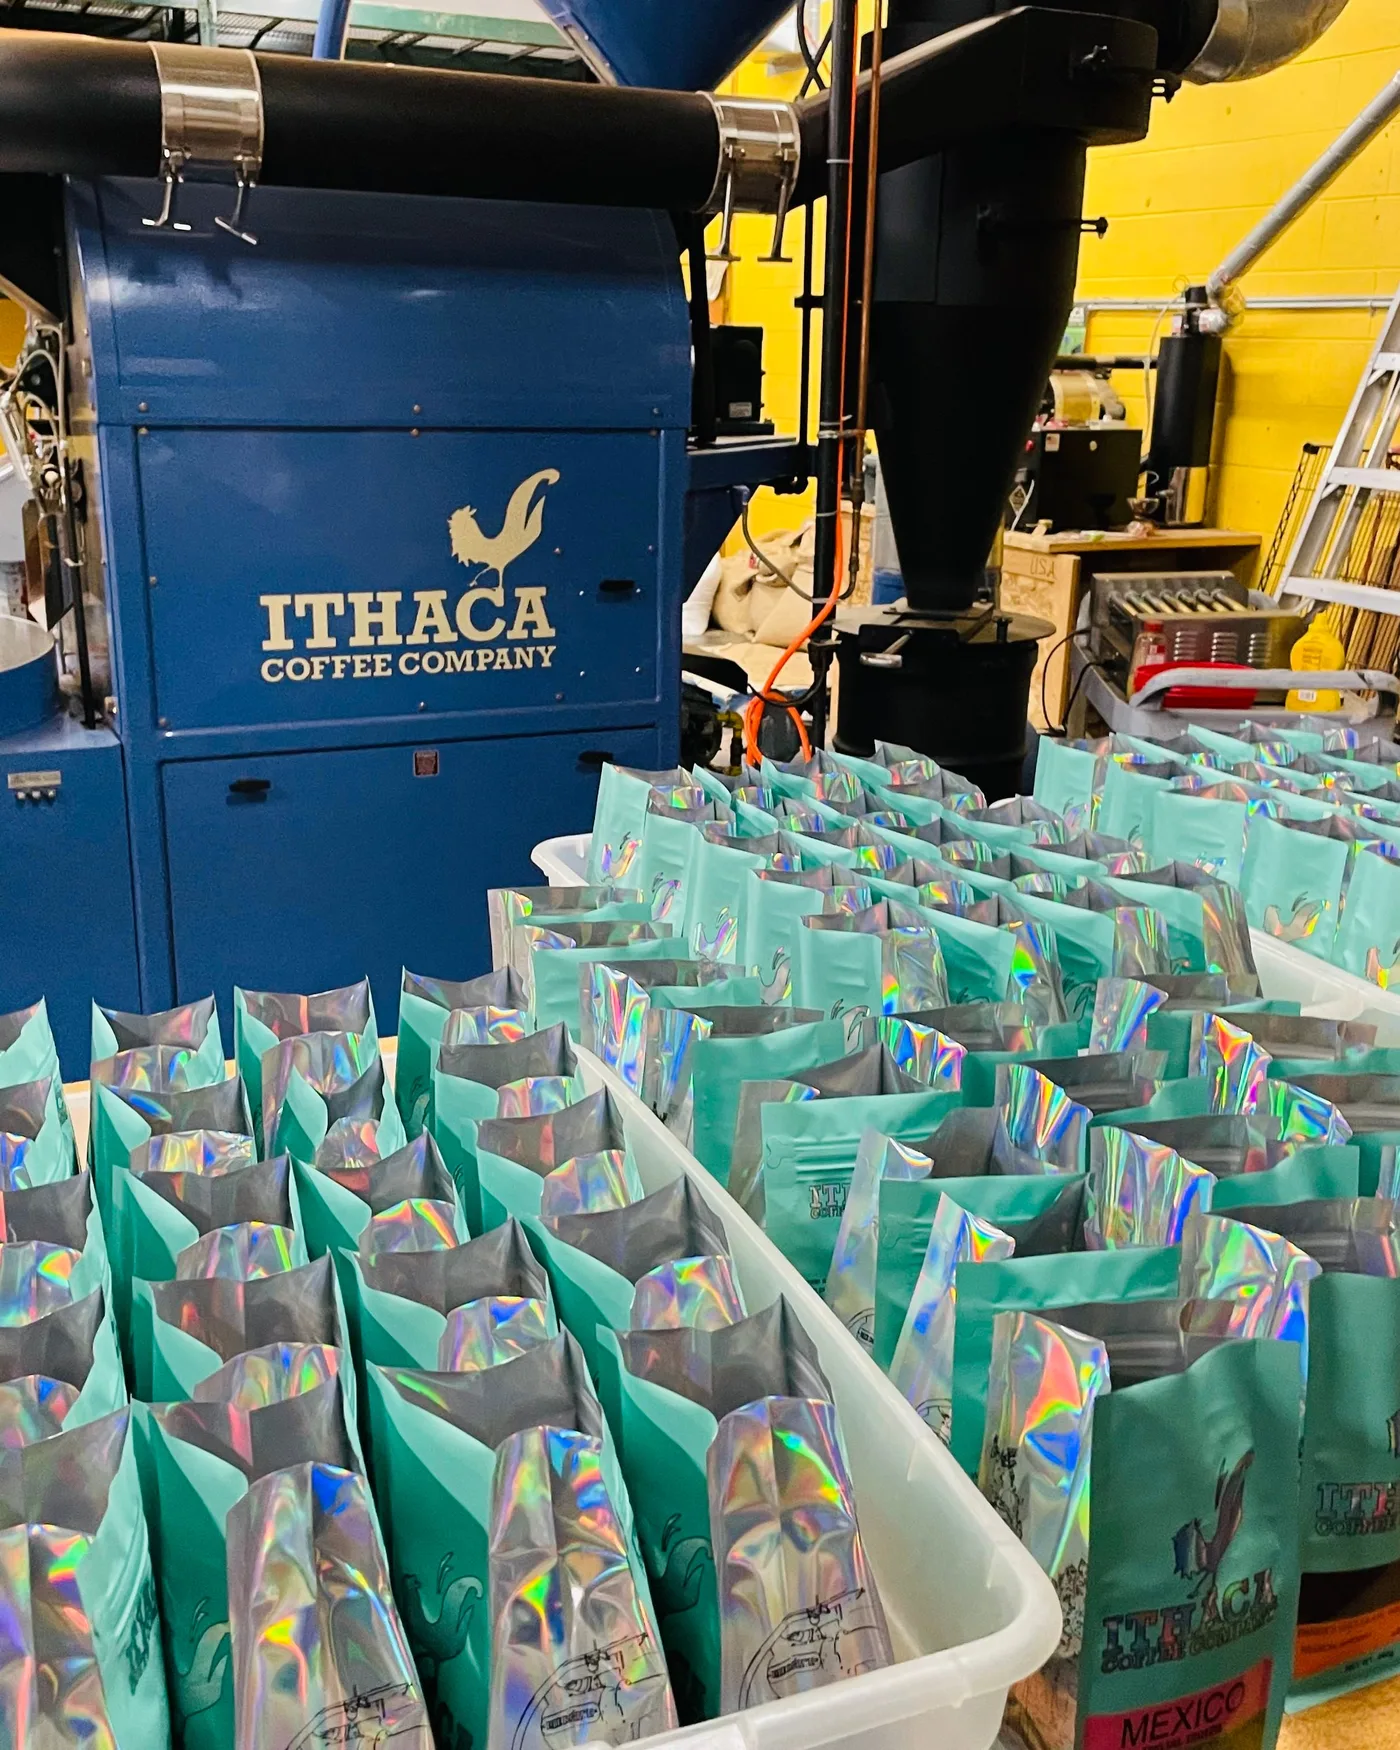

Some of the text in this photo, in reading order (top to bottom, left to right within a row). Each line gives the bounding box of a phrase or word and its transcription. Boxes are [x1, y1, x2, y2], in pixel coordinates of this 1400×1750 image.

[260, 586, 556, 651] ITHACA
[261, 645, 556, 682] COFFEE COMPANY
[1120, 1681, 1246, 1749] MEXICO
